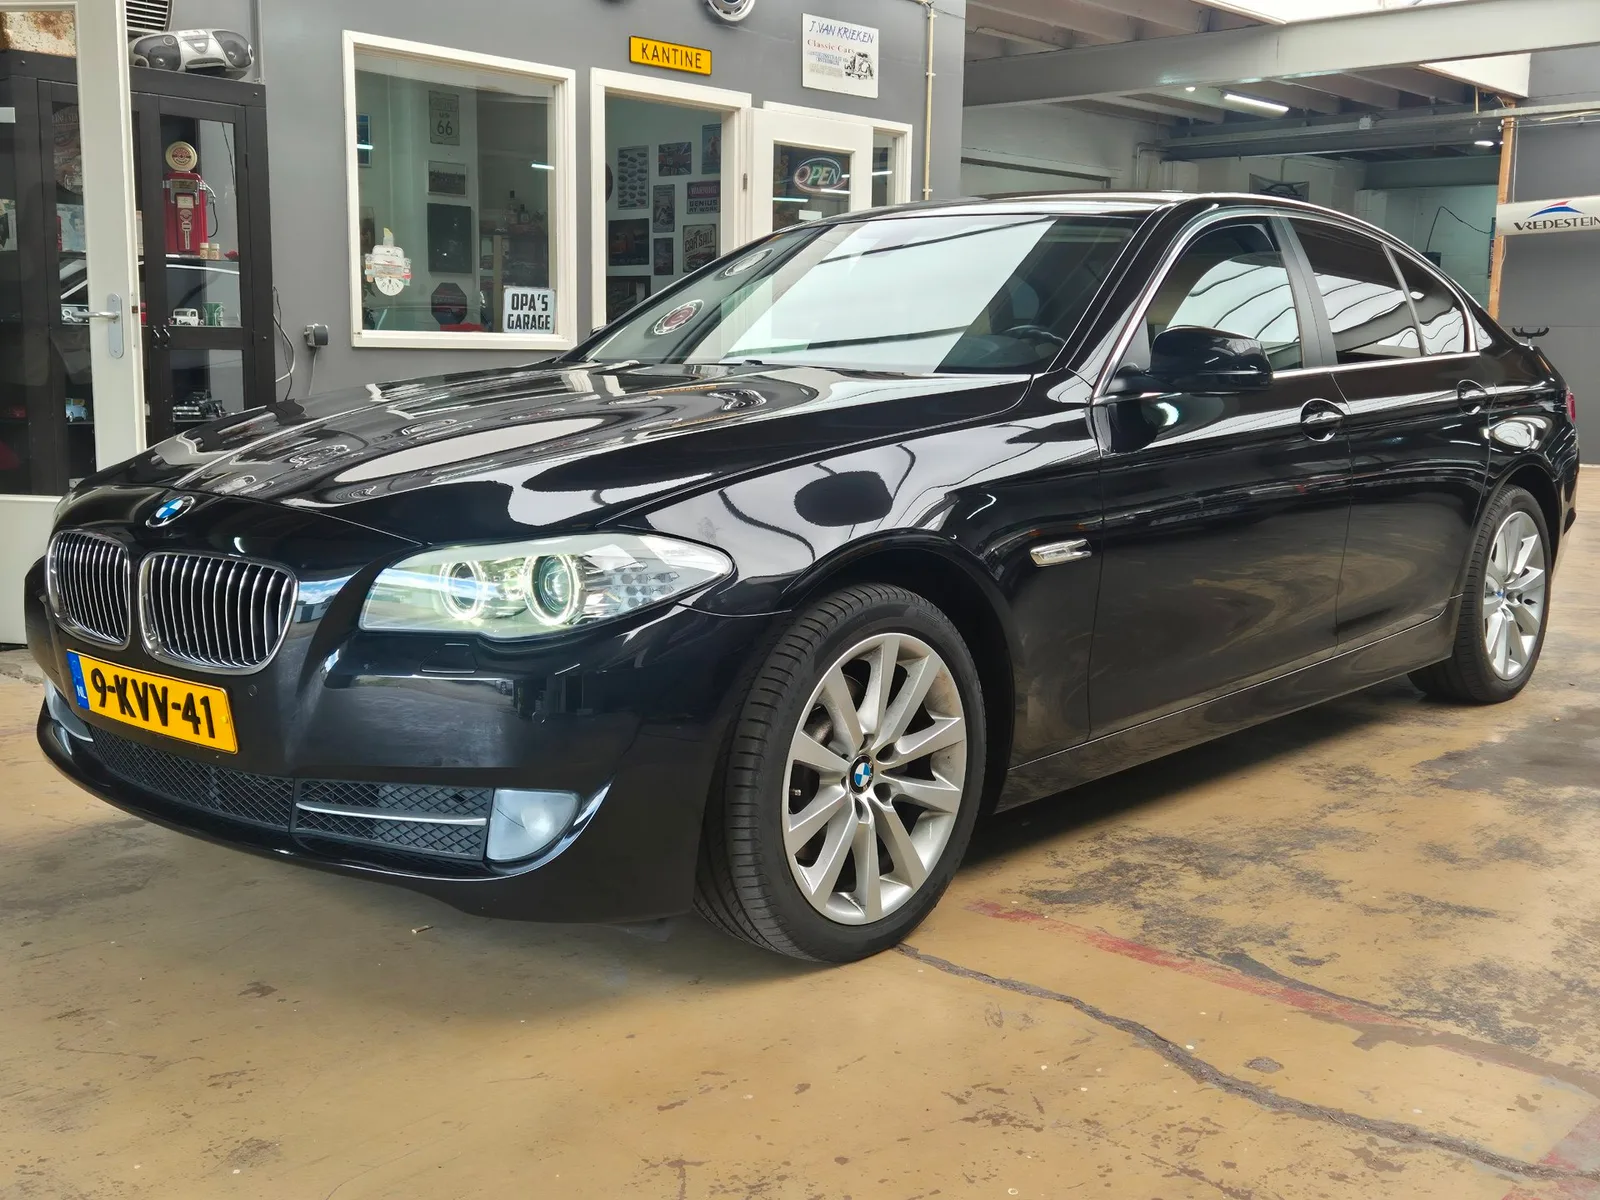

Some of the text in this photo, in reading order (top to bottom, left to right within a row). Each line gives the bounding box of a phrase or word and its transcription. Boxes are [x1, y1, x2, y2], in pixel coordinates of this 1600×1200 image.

[837, 26, 874, 43] KRIEKEN
[807, 39, 855, 54] Classic Cars
[641, 42, 702, 69] KANTINE
[437, 120, 453, 136] 66
[797, 164, 840, 185] OPEN
[689, 199, 718, 207] GENIUS
[1514, 216, 1600, 231] VREDESTEIN
[685, 236, 698, 253] CAR
[699, 229, 713, 247] SALE
[511, 293, 549, 311] OPA'S
[507, 313, 551, 330] GARAGE
[76, 684, 88, 700] NL
[90, 667, 216, 740] 9-KVV-41
